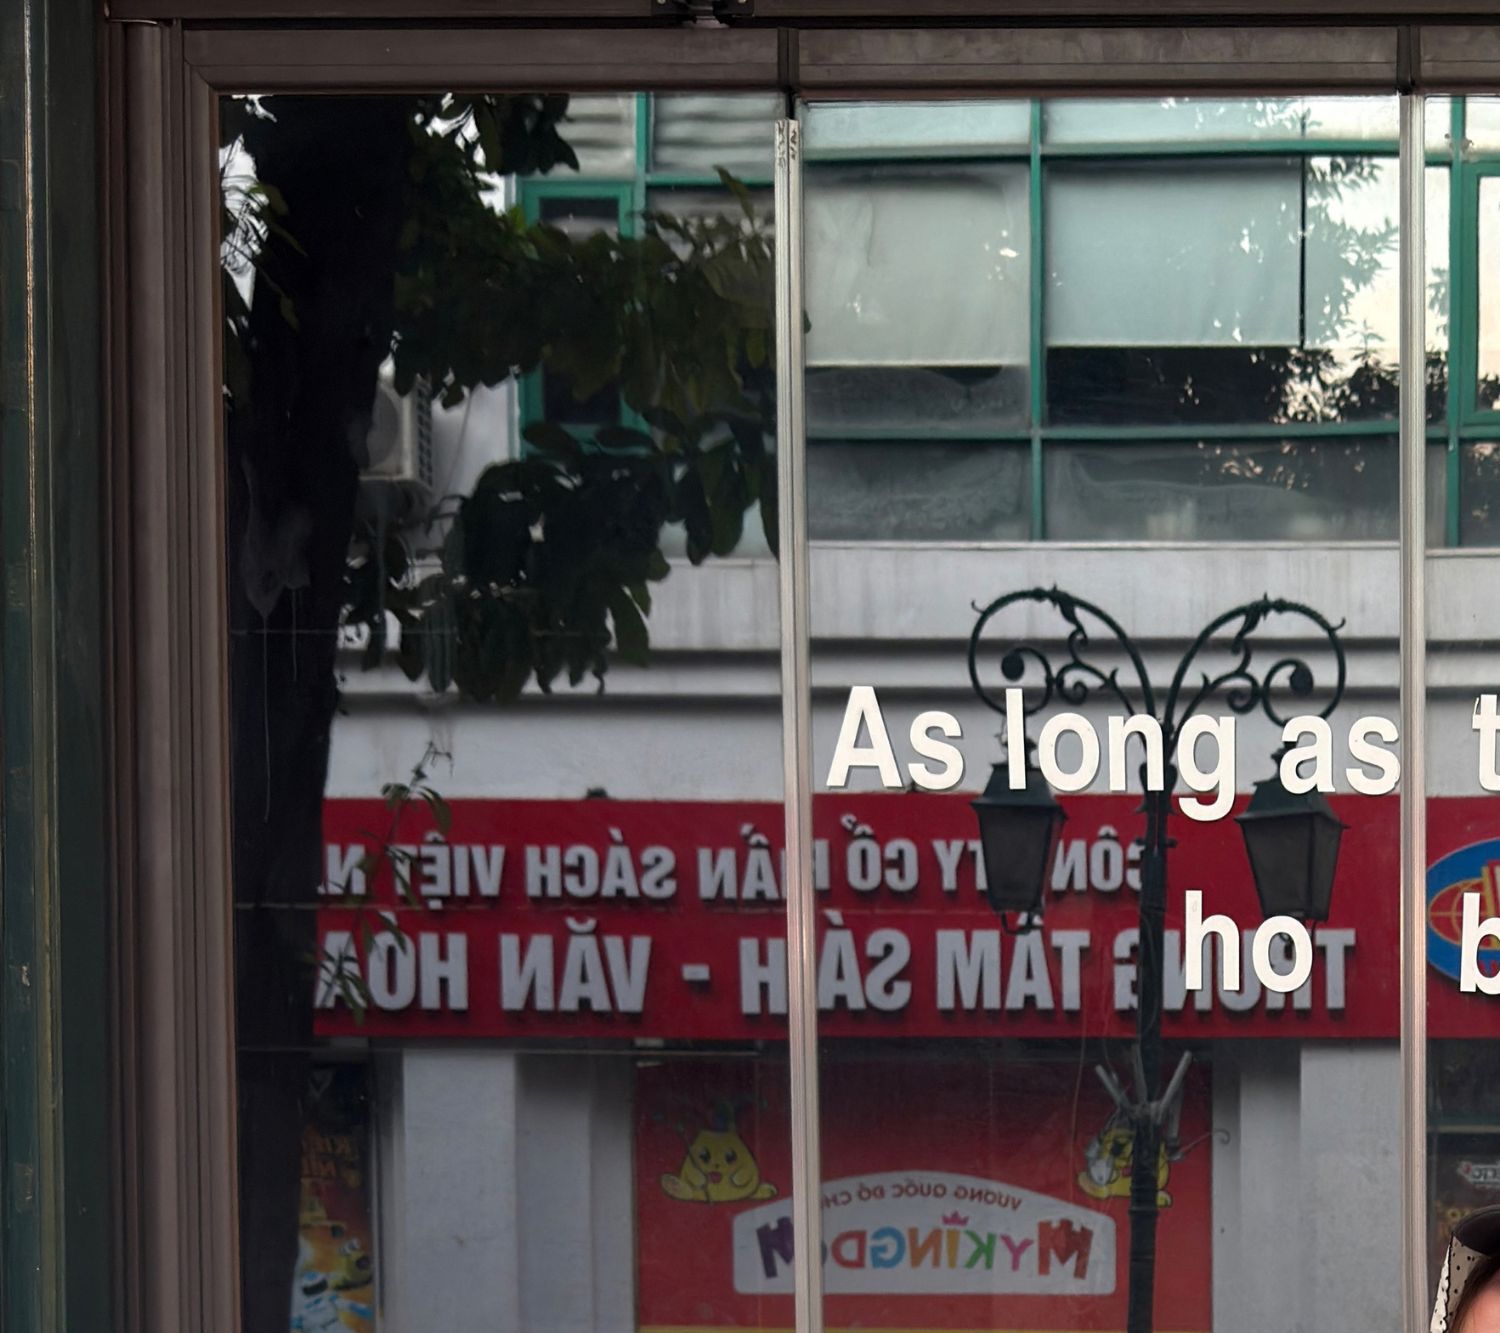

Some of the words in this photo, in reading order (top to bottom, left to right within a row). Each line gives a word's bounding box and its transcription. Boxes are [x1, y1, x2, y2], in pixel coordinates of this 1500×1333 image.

[826, 685, 966, 792] As
[1006, 687, 1238, 822] long
[1279, 713, 1401, 795] as
